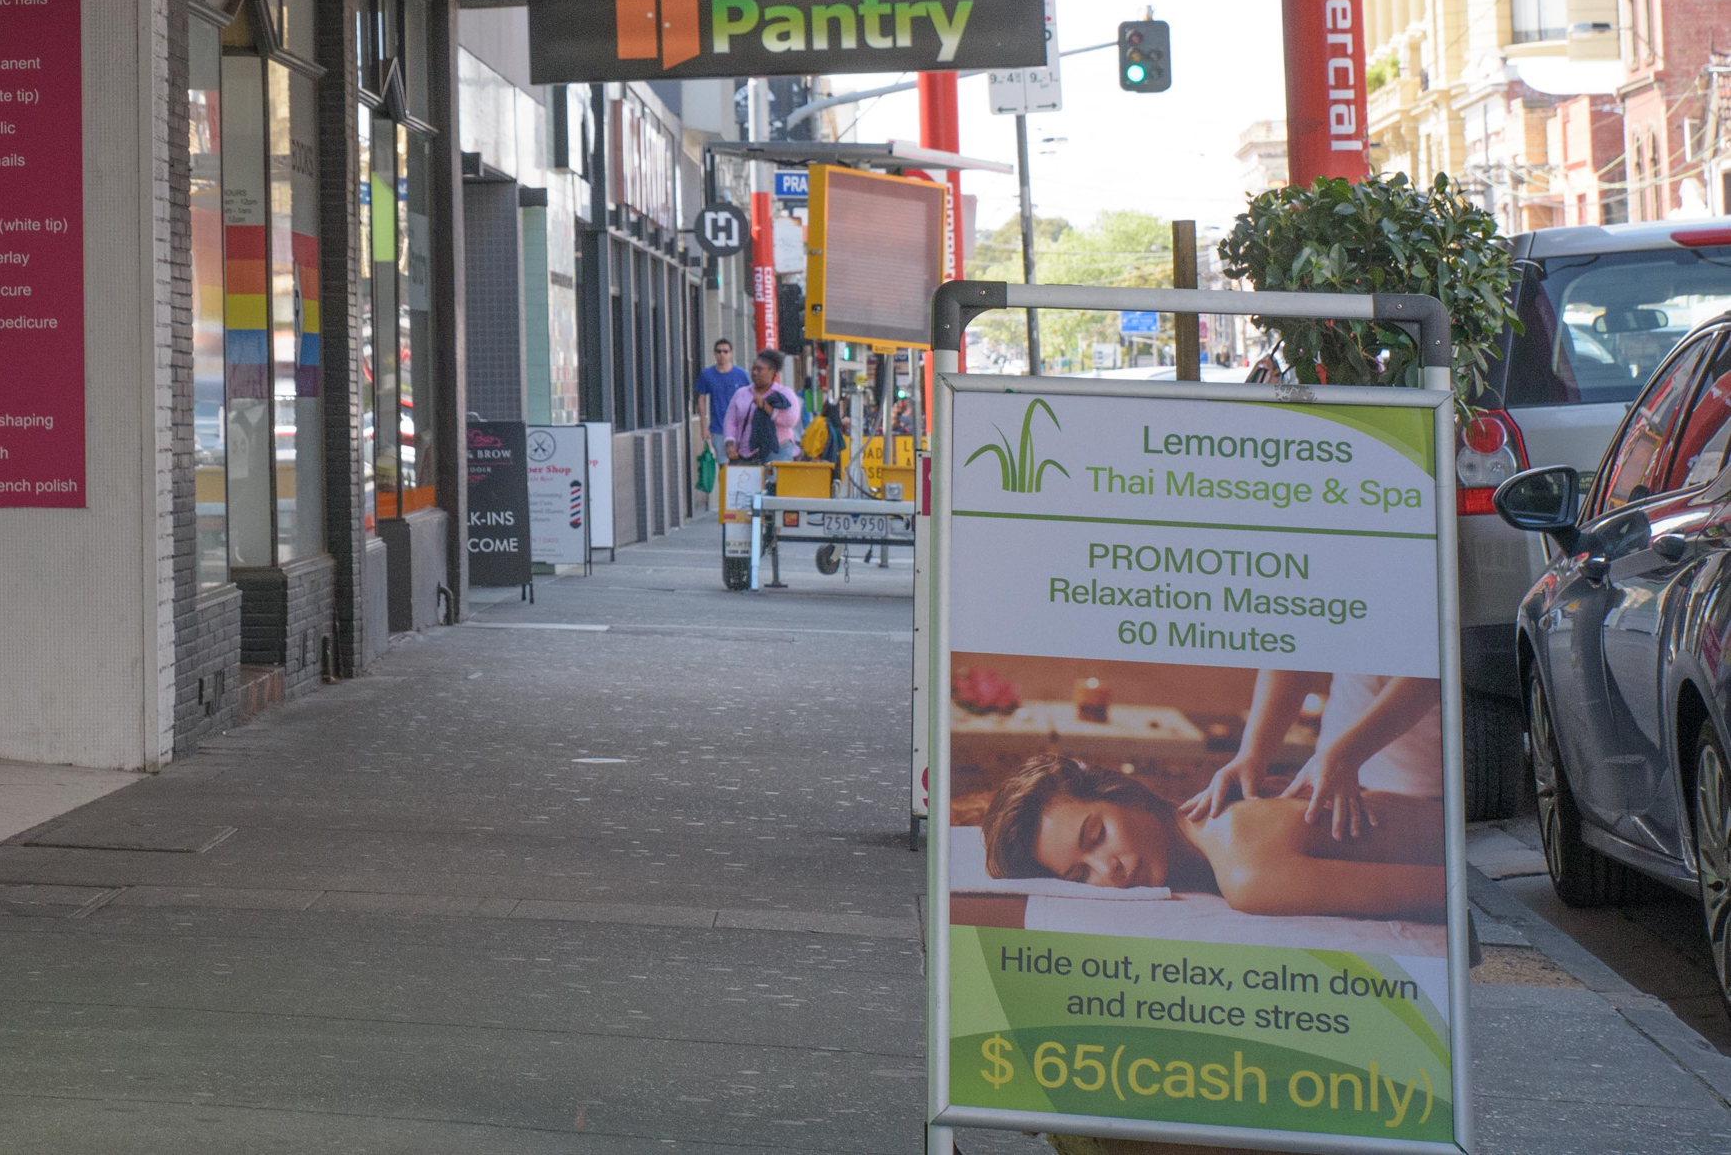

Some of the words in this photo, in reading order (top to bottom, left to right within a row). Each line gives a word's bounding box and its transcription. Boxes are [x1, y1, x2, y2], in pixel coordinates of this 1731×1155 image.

[17, 89, 39, 104] tip)
[0, 218, 40, 234] (white
[45, 217, 68, 233] tip)
[477, 450, 512, 459] BROW
[1143, 425, 1352, 468] Lemongrass
[36, 478, 77, 494] polish
[546, 465, 571, 476] Shop
[1085, 466, 1154, 497] Thai
[1164, 473, 1311, 509] Massage
[1323, 479, 1349, 506] &
[1360, 482, 1422, 513] Spa
[1088, 543, 1310, 579] PROMOTION
[1048, 578, 1212, 613] Relaxation
[1222, 589, 1367, 623] Massage
[1117, 620, 1158, 646] 60
[1168, 623, 1296, 654] Minutes
[1000, 945, 1072, 977] Hide
[1082, 955, 1140, 986] out,
[1150, 957, 1232, 992] relax,
[1243, 964, 1320, 995] calm
[1329, 968, 1419, 1001] down
[1066, 991, 1125, 1020] and
[1135, 996, 1245, 1028] reduce
[1254, 1005, 1350, 1035] stress
[979, 1033, 1014, 1091] $
[1033, 1040, 1268, 1104] 65(cash
[1289, 1060, 1434, 1129] only)
